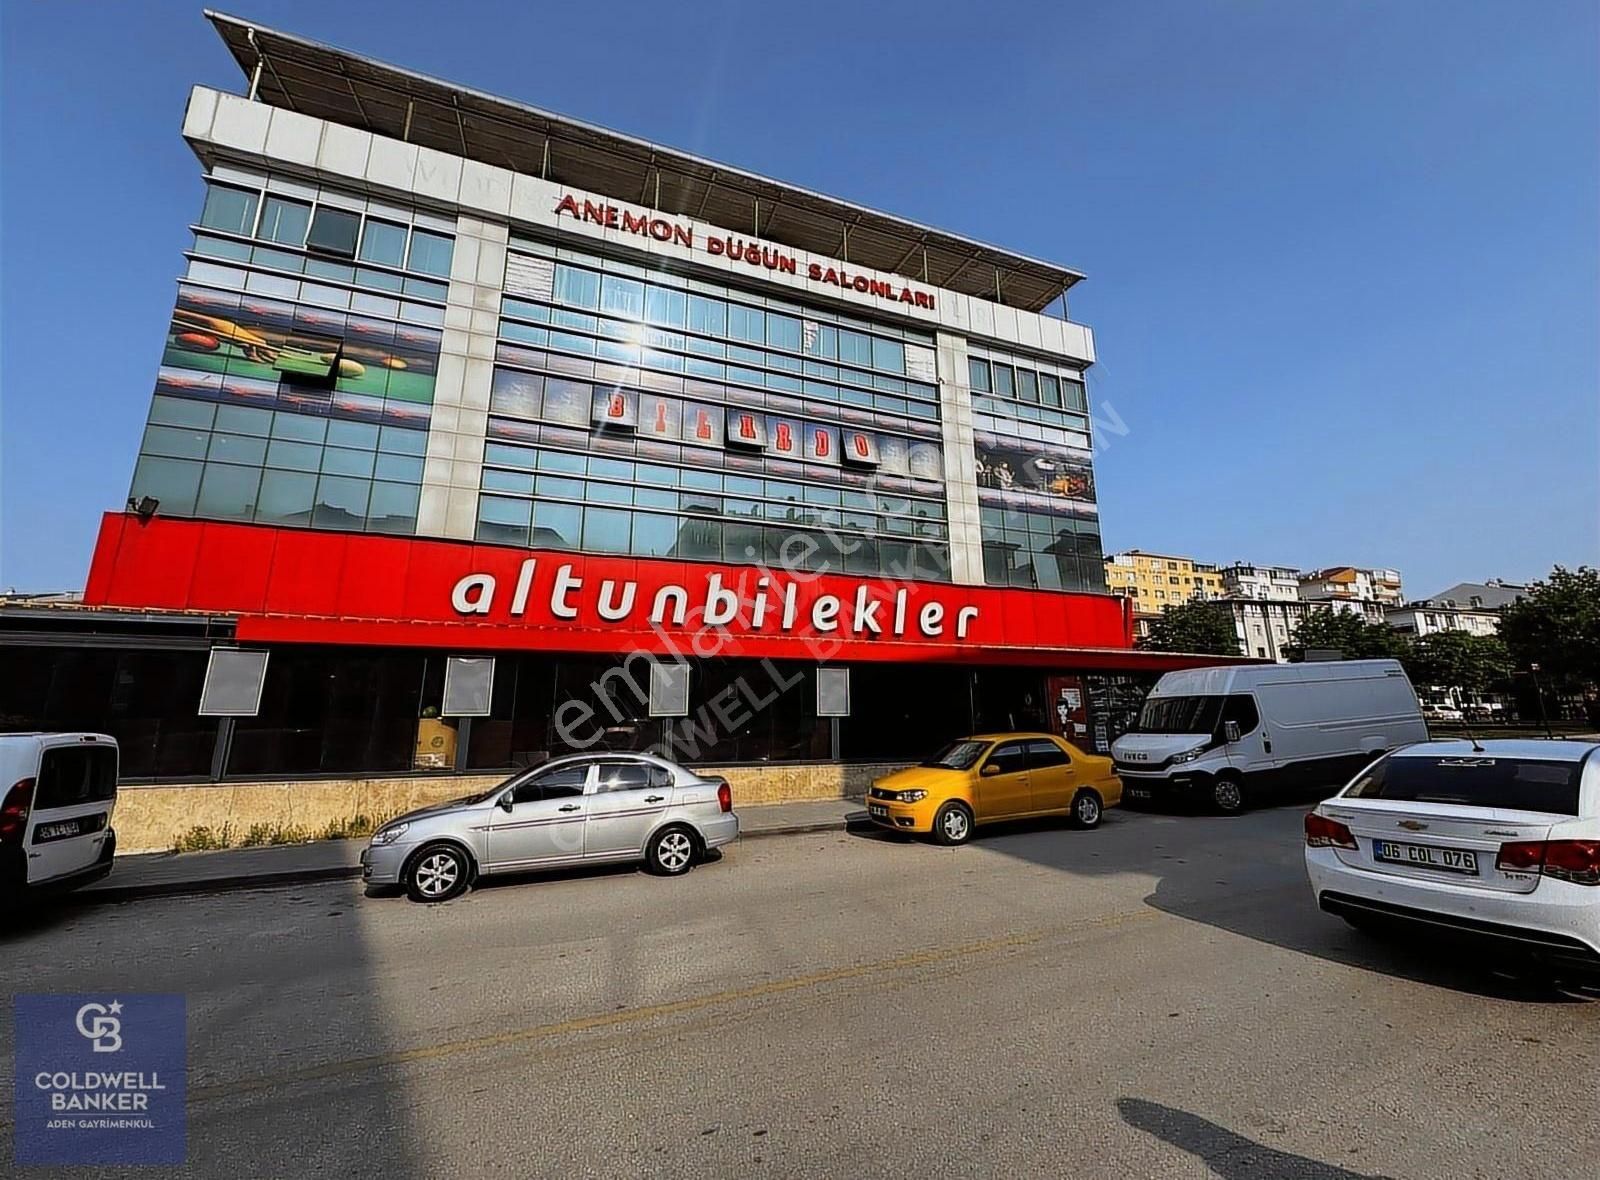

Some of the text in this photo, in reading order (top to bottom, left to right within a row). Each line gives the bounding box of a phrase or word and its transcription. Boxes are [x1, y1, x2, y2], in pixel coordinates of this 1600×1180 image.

[555, 195, 935, 309] ANEMON DÜĞÜN SALONLARI
[452, 558, 978, 638] altunbilekler
[1383, 844, 1401, 859] 06
[1442, 851, 1475, 869] 076
